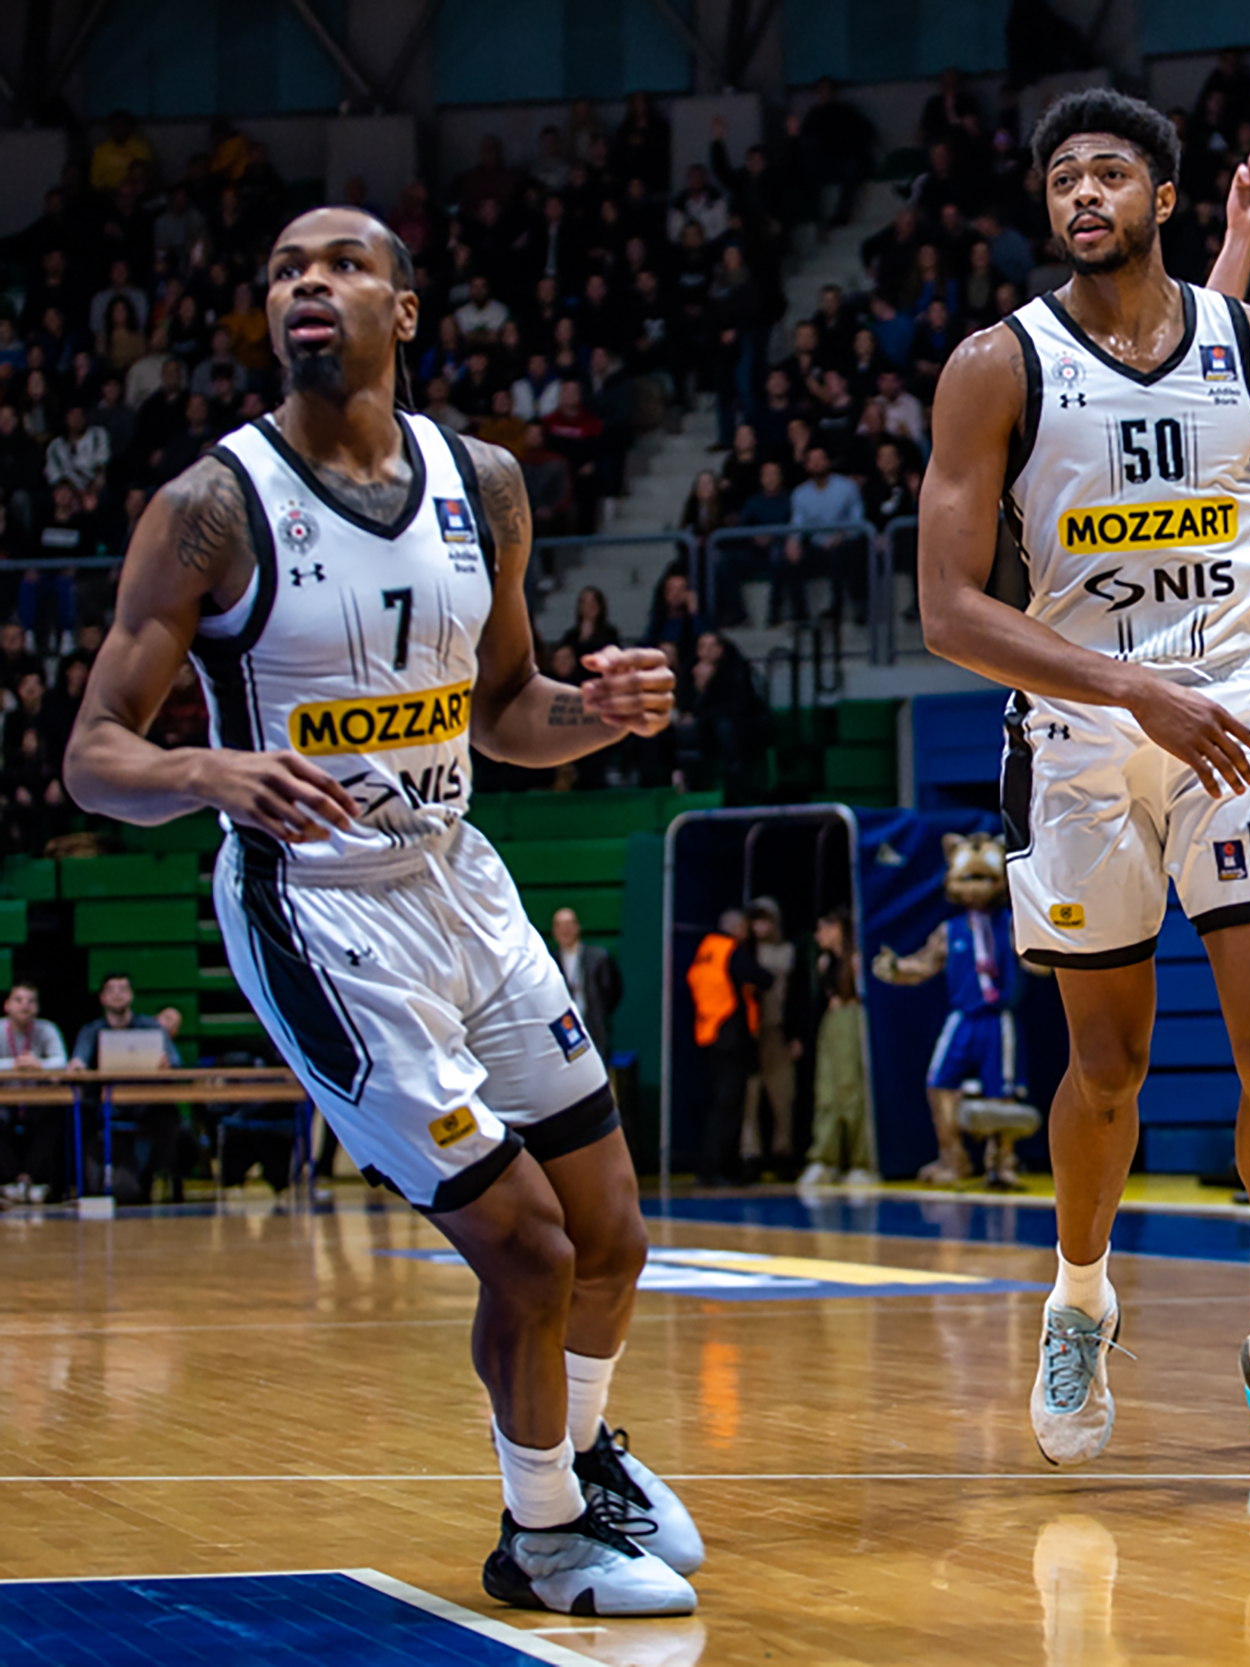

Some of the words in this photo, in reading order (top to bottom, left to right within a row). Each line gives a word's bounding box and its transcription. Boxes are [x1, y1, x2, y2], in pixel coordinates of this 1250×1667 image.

[1121, 418, 1184, 484] 50
[1066, 504, 1234, 546] MOZZART
[1153, 560, 1236, 603] NIS
[381, 586, 413, 673] 7
[399, 756, 462, 810] NIS
